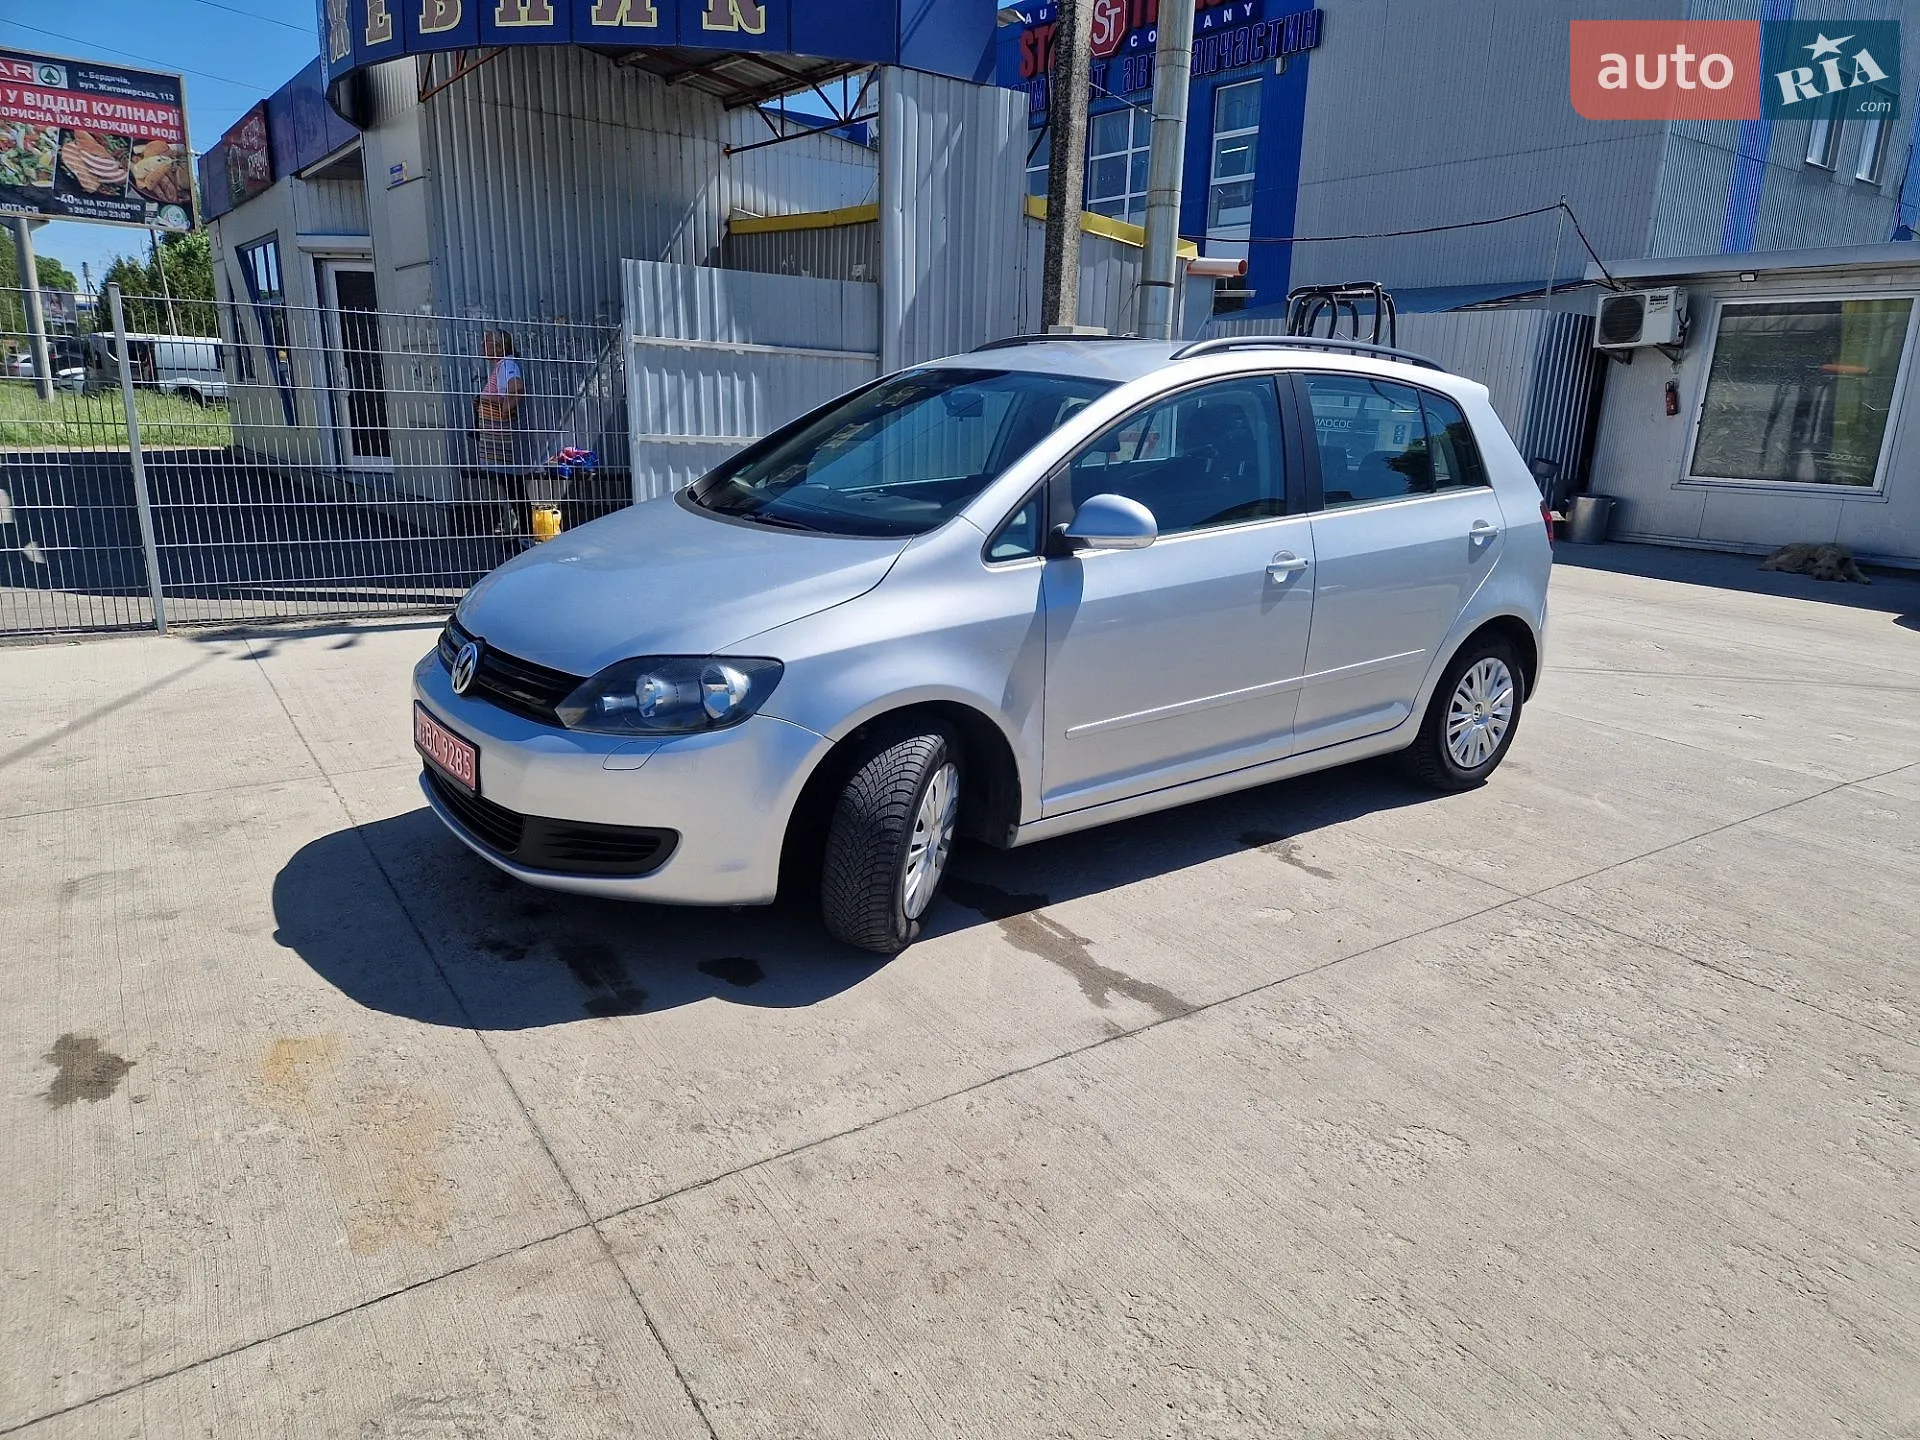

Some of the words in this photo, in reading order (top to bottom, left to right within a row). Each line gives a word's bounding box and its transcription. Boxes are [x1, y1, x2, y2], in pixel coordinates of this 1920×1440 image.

[6, 88, 18, 103] У
[23, 91, 88, 114] ВІДДІЛ
[92, 101, 180, 126] КУЛІНАРІЇ
[160, 92, 175, 102] 113
[0, 106, 54, 122] ОРИСНА
[84, 117, 137, 134] ЗАВЖДИ
[140, 125, 148, 135] В
